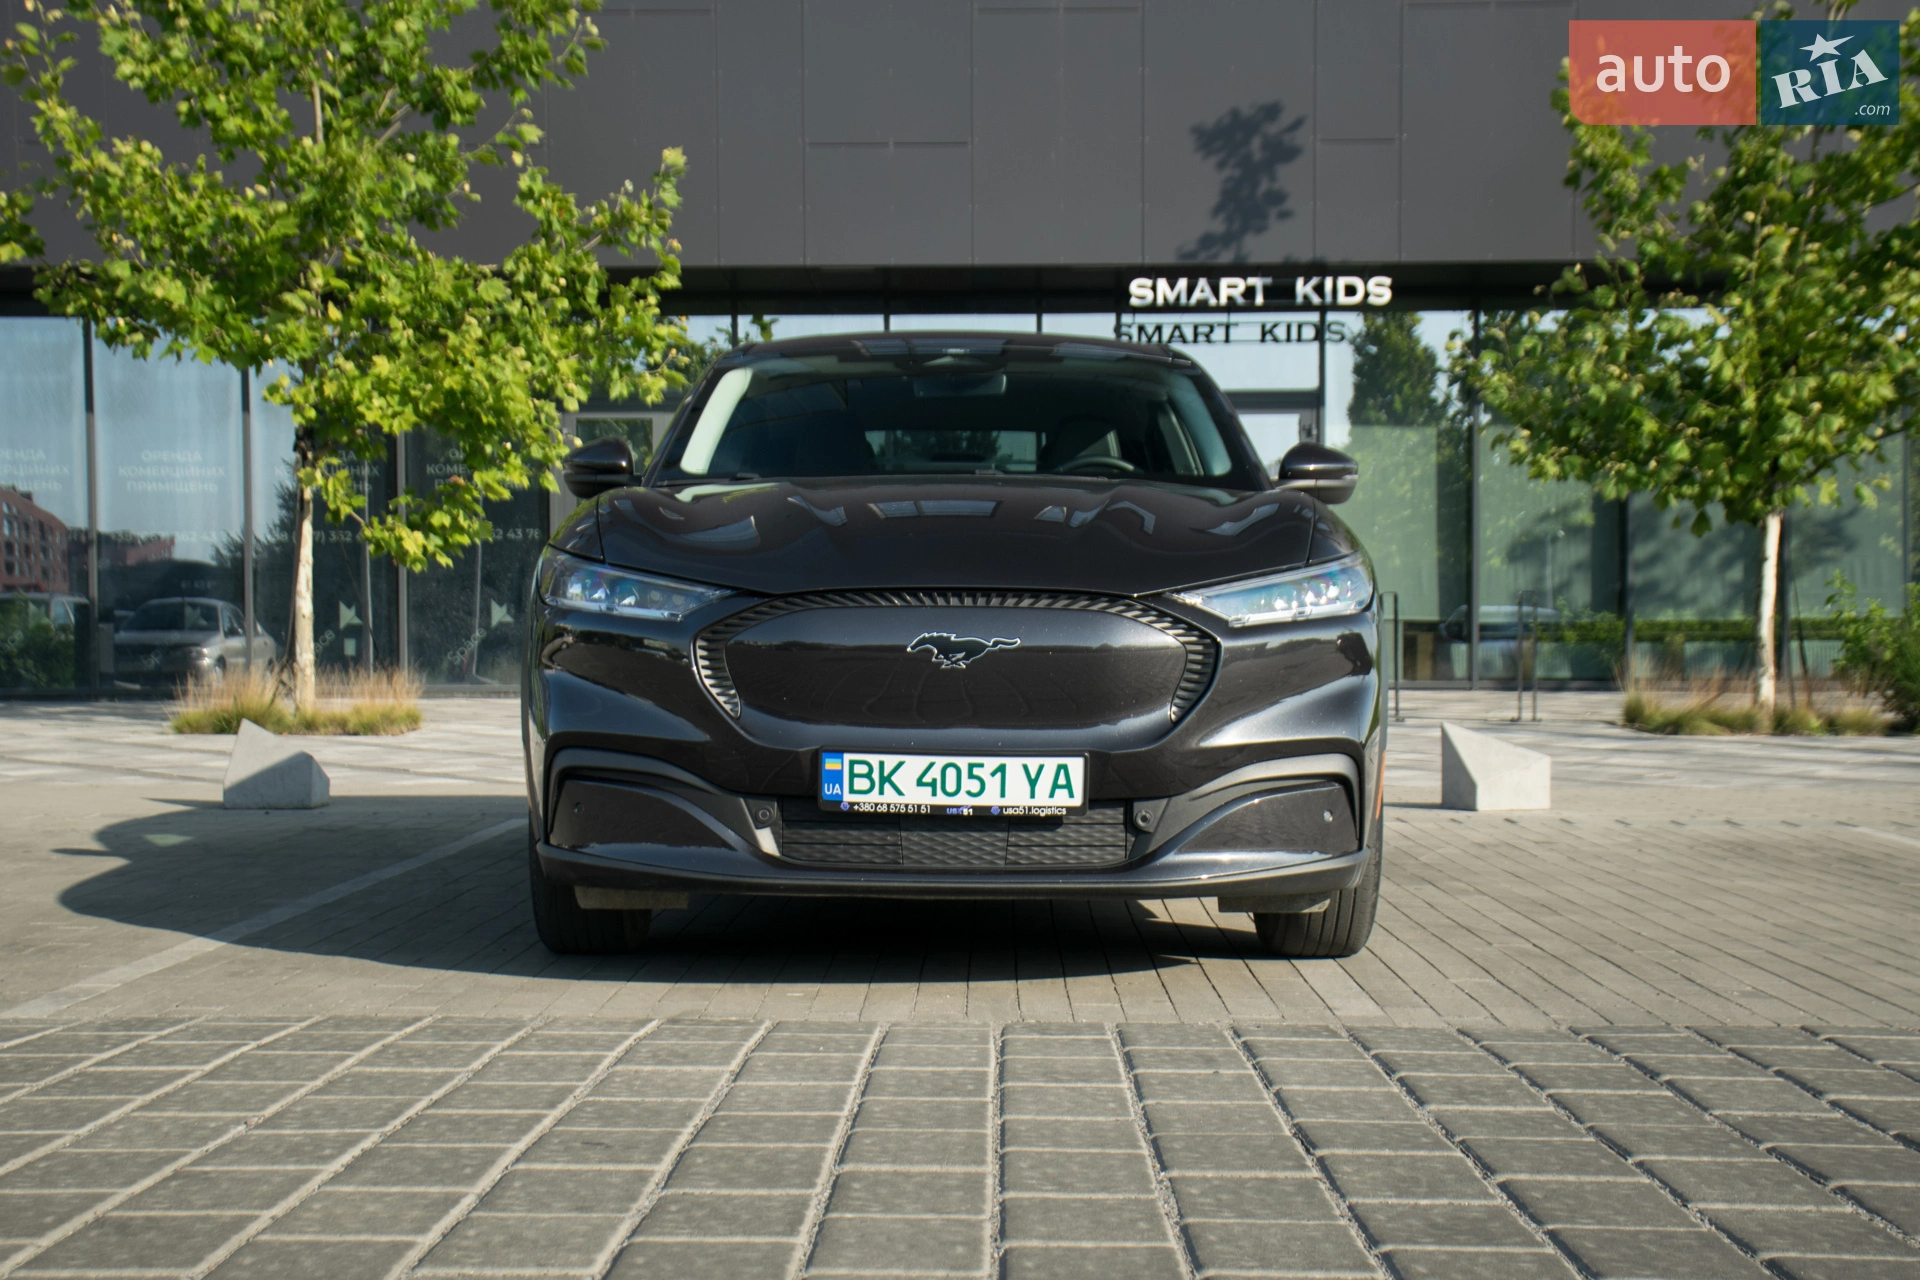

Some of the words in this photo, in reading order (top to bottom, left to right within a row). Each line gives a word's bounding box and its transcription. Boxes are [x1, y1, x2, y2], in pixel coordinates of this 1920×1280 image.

[1129, 276, 1273, 307] SMART
[1295, 276, 1393, 306] KIDS
[1114, 322, 1239, 344] SMART
[1260, 321, 1347, 343] KIDS
[141, 449, 202, 463] ОРЕНДА
[506, 528, 523, 540] 43
[848, 759, 906, 796] BK
[916, 761, 1007, 798] 4051
[1022, 763, 1075, 799] YA
[824, 783, 842, 795] UA
[853, 802, 876, 813] +380
[876, 803, 888, 813] 68
[890, 803, 907, 813] 575
[908, 804, 918, 813] 51
[920, 804, 931, 814] 51
[1003, 805, 1067, 816] usa51.logistics
